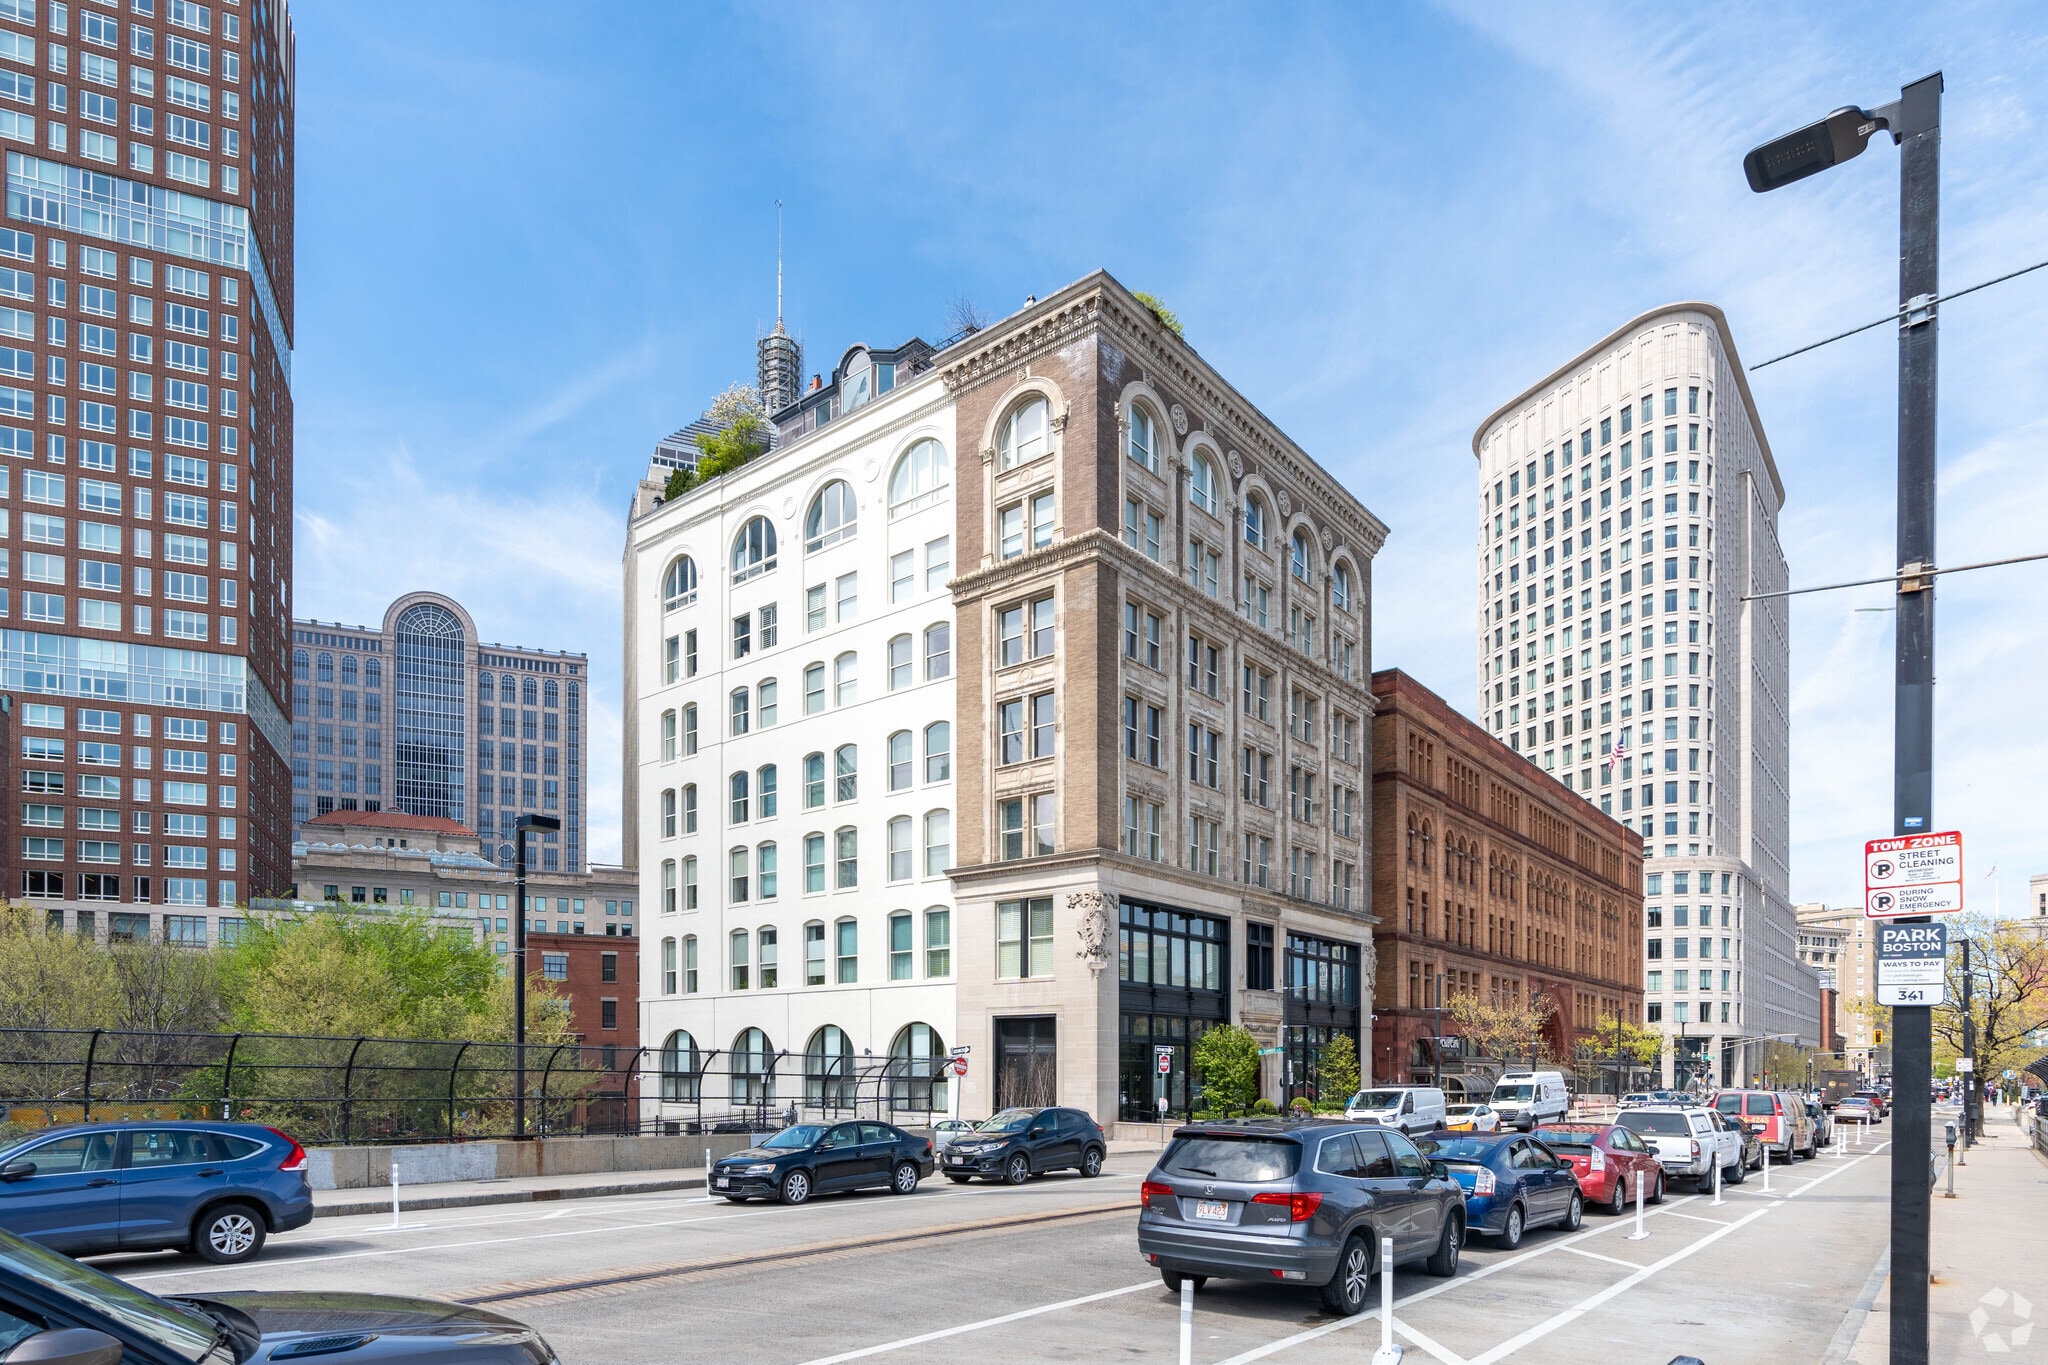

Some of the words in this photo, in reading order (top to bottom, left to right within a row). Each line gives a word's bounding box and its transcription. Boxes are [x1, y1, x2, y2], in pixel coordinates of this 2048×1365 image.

[1870, 840, 1905, 851] TOW
[1910, 834, 1956, 847] ZONE
[1899, 849, 1941, 860] STREET
[1899, 857, 1954, 869] CLEANING
[1899, 888, 1934, 896] DURING
[1899, 895, 1928, 903] SNOW
[1899, 900, 1951, 910] EMERGENCY
[1883, 928, 1941, 942] PARK
[1883, 942, 1941, 952] BOSTON
[1898, 990, 1924, 1001] 341
[1213, 1206, 1226, 1216] 423
